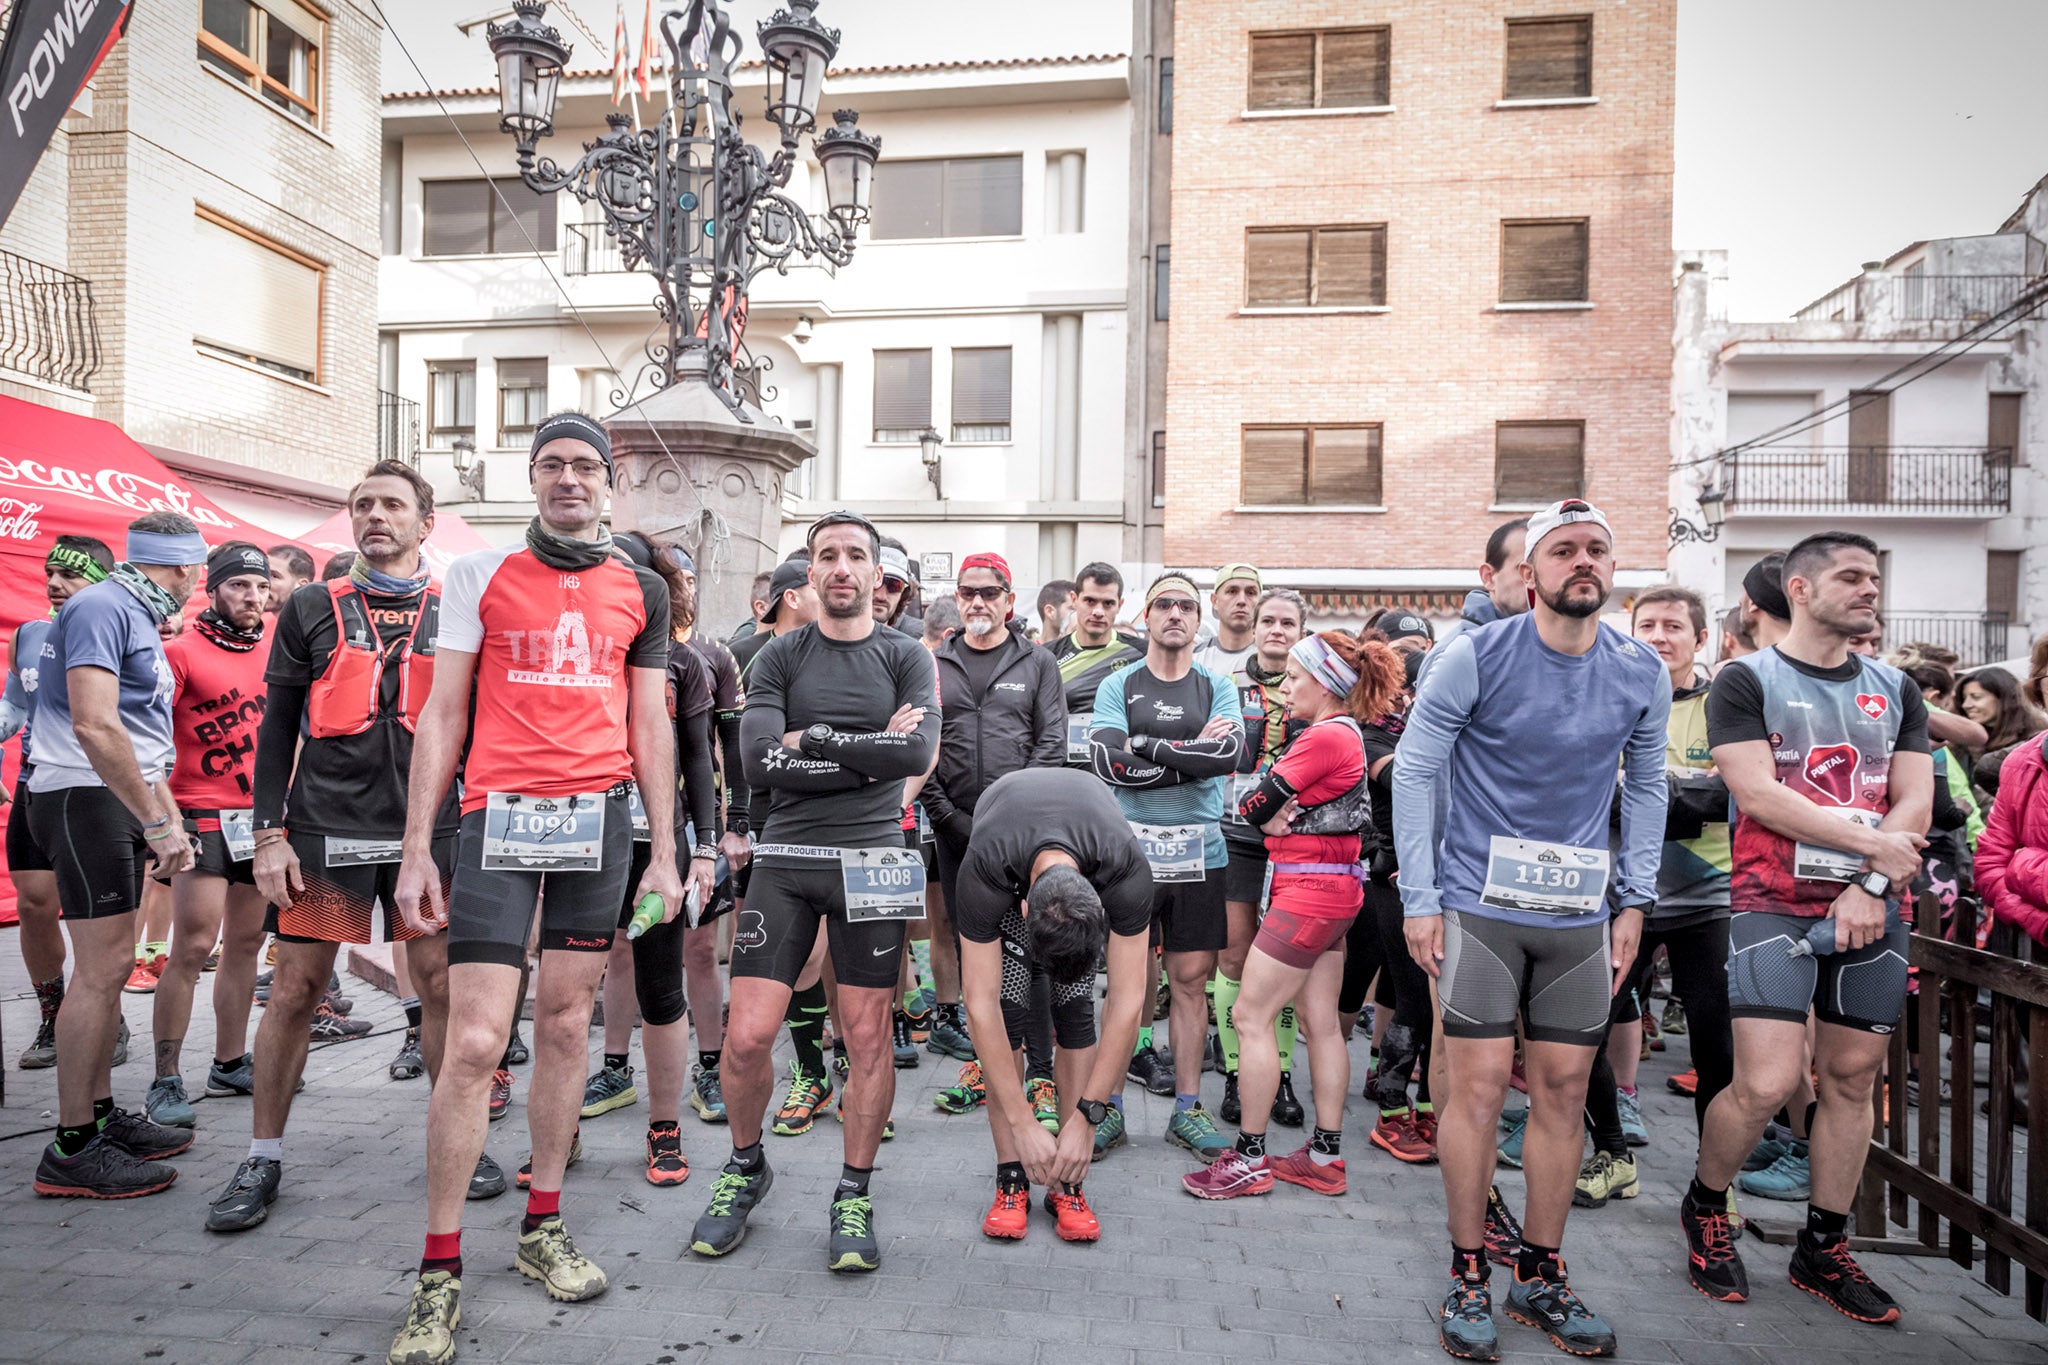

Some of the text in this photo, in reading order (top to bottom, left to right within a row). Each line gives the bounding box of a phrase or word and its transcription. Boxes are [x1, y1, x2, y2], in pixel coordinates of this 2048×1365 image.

[8, 0, 101, 137] POWE
[0, 457, 235, 528] oca-Cola
[1126, 765, 1164, 777] LURBEL
[1810, 755, 1846, 779] PUNTAL
[513, 814, 577, 835] 1090
[788, 847, 834, 857] ROQUETTE
[1144, 842, 1188, 857] 1055
[866, 868, 911, 886] 1008
[1515, 864, 1580, 889] 1130
[292, 893, 346, 906] orremón
